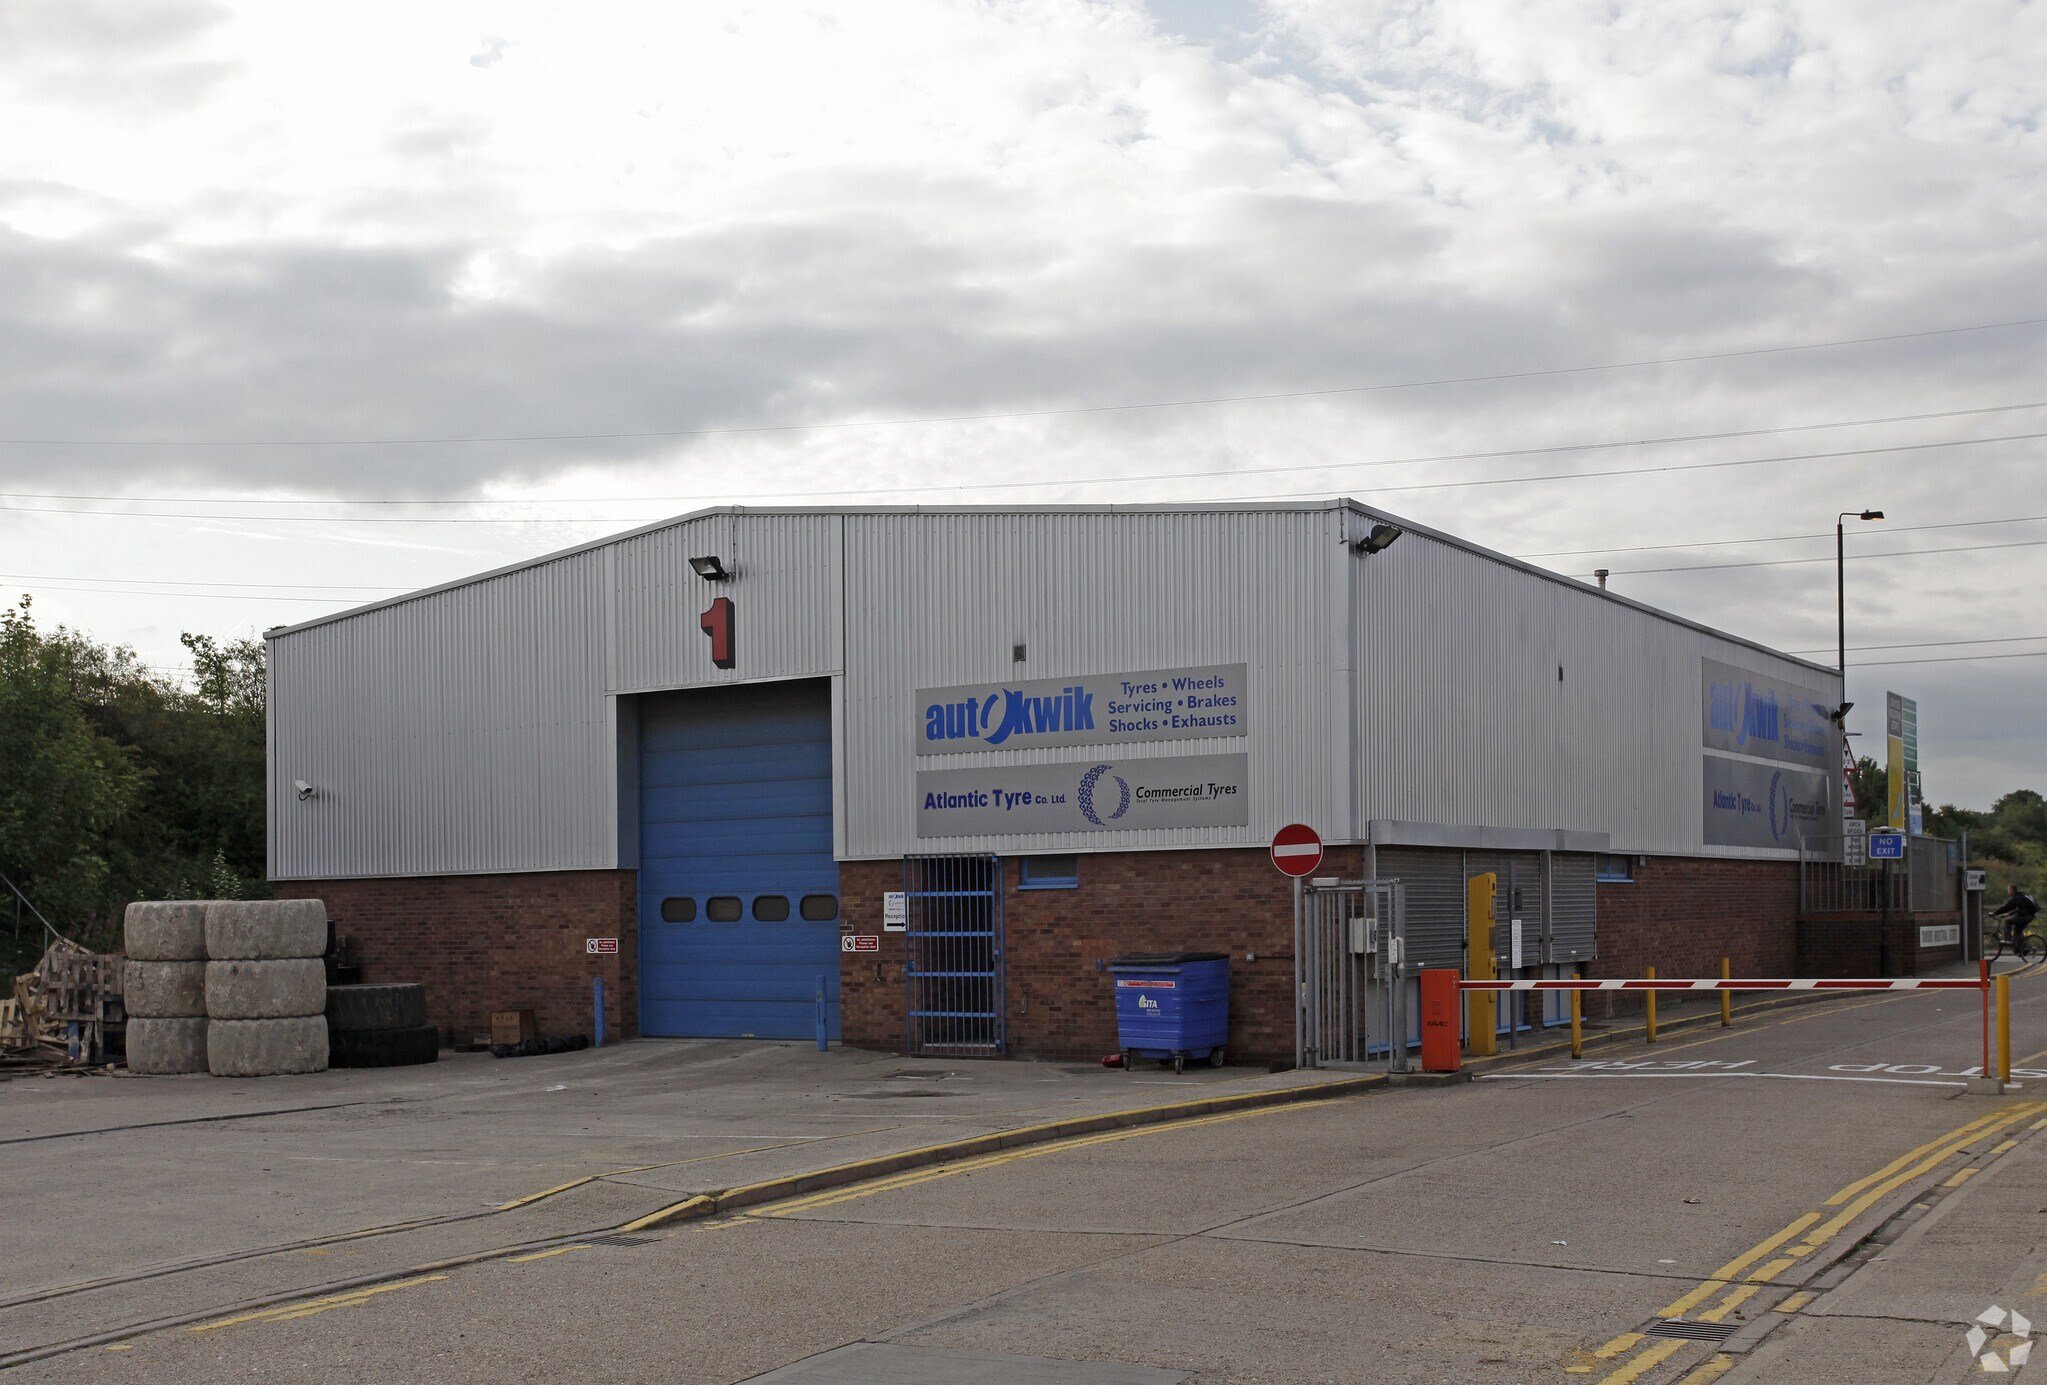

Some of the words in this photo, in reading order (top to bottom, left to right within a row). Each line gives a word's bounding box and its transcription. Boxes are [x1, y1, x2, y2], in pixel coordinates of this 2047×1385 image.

[701, 597, 736, 669] 1
[1121, 682, 1157, 698] Tyres
[1171, 675, 1225, 691] Wheels
[1108, 698, 1173, 714] Servicing
[1188, 694, 1237, 709] Brakes
[1109, 717, 1158, 733] Shocks
[1171, 714, 1237, 729] Exhausts
[924, 790, 988, 810] Atlantic
[992, 789, 1032, 811] Tyre
[1035, 795, 1049, 805] Co.
[1051, 794, 1067, 804] Ltd.
[1136, 784, 1203, 799] Commercial
[1208, 783, 1237, 799] Tyres
[1879, 837, 1893, 845] NO
[1876, 847, 1895, 855] EXIT
[1143, 1000, 1158, 1008] SITA
